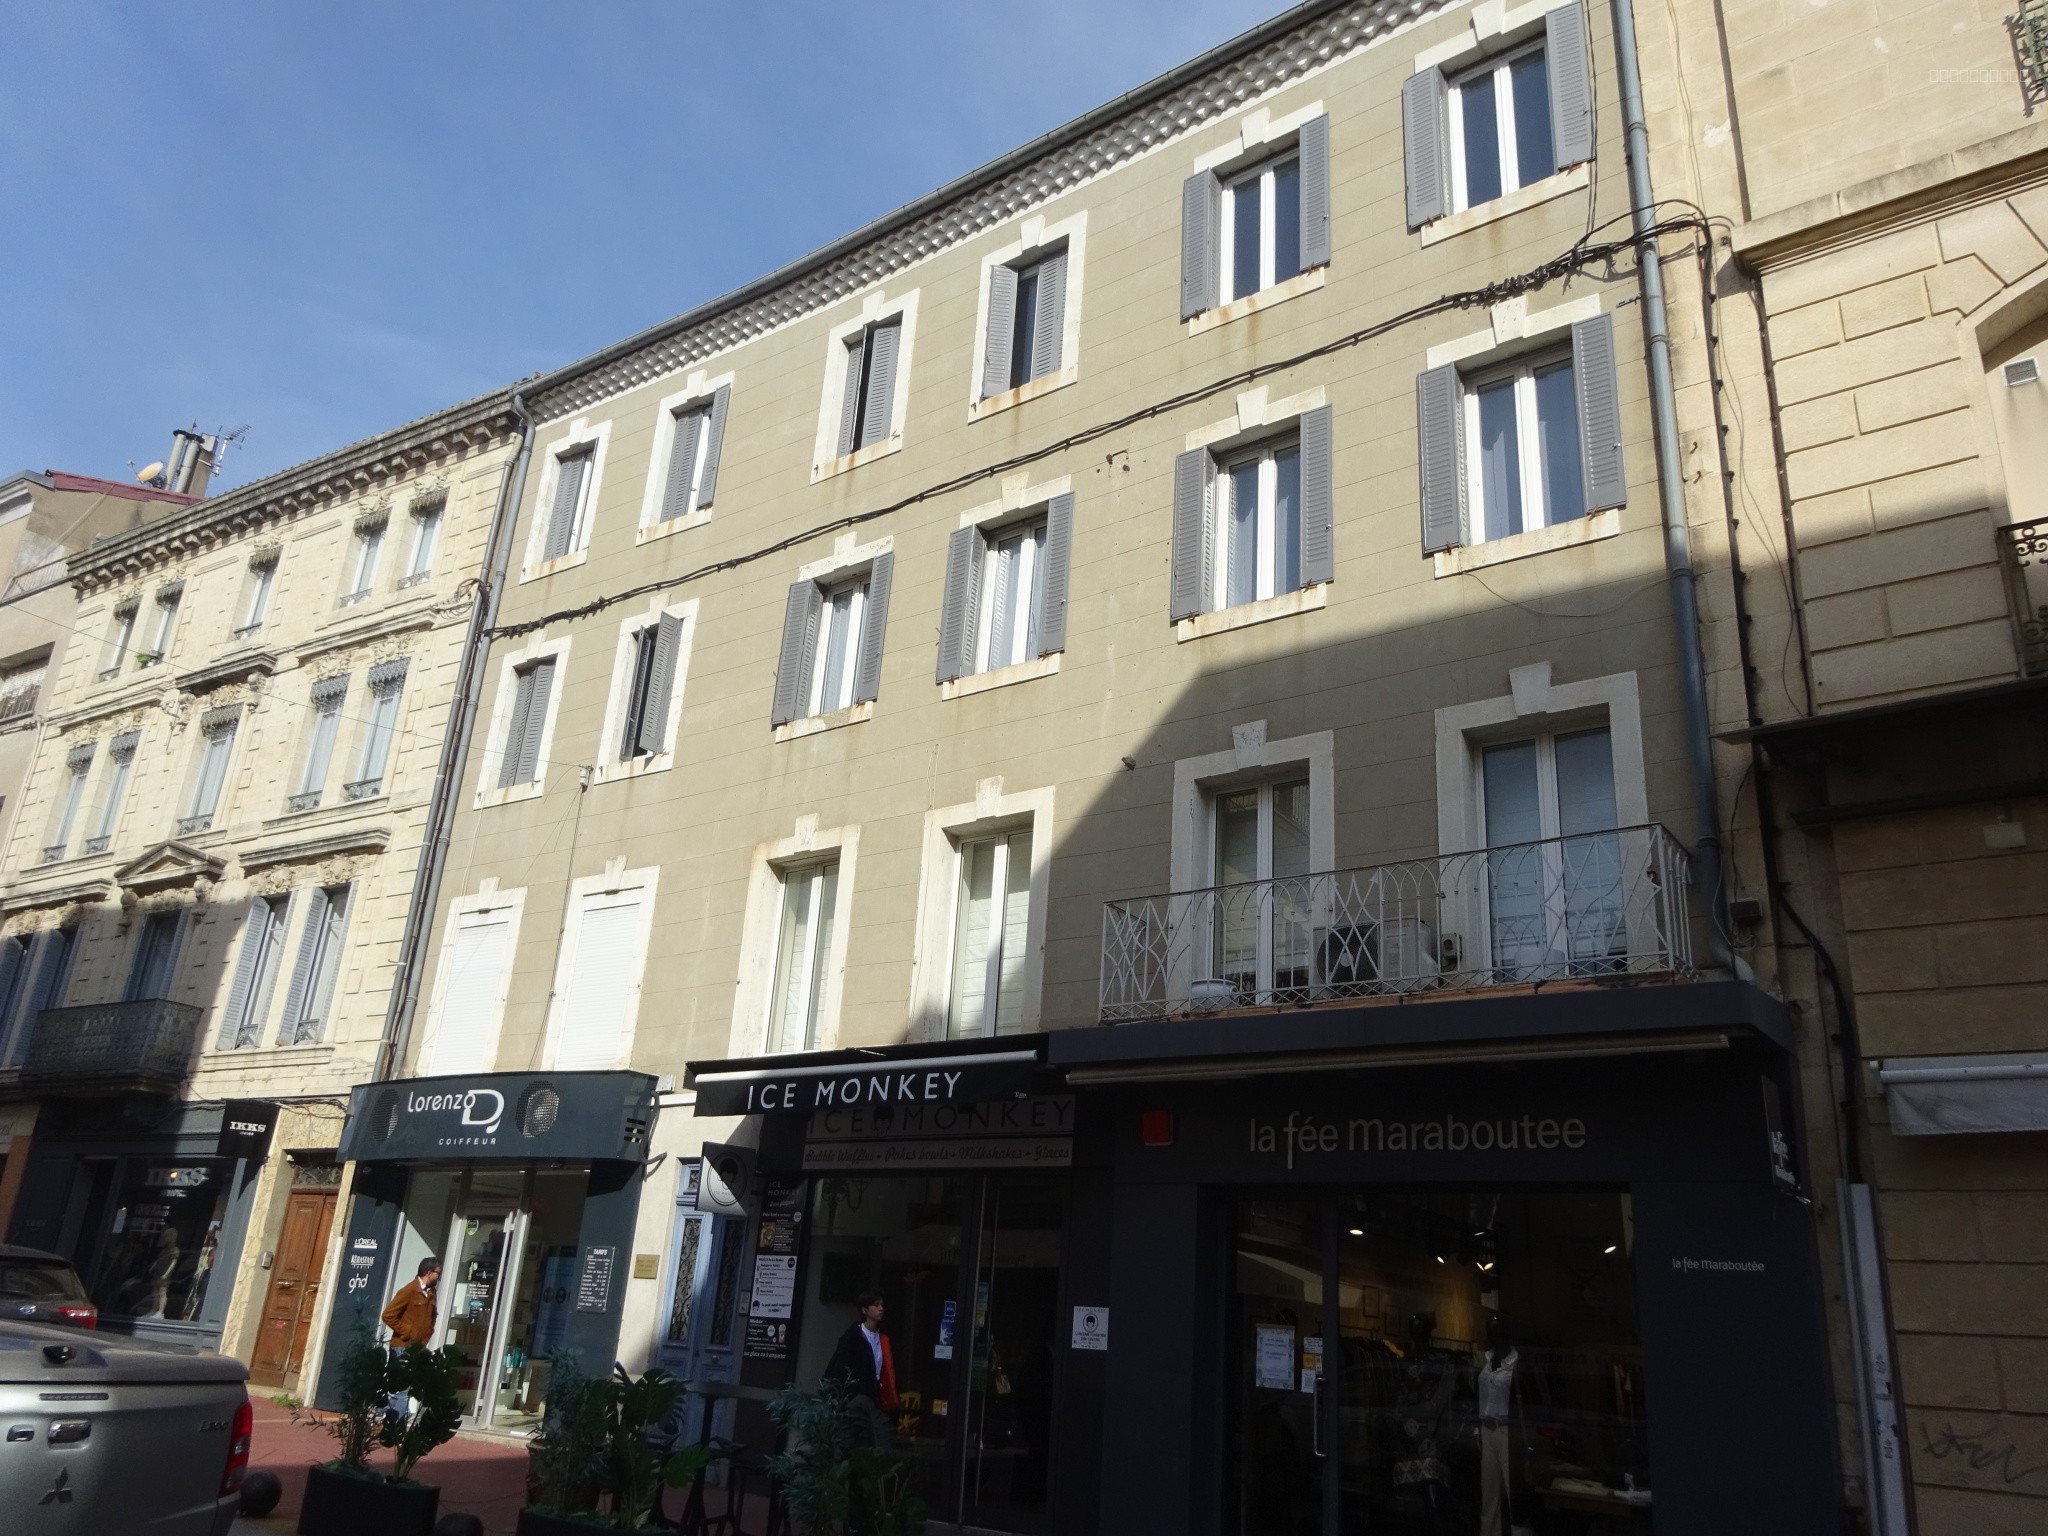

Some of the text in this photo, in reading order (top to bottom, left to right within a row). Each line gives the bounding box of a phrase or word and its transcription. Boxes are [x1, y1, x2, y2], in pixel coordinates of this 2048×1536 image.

[747, 1071, 963, 1110] ICE MONKEY
[229, 1121, 267, 1133] IKKS
[808, 1099, 1073, 1134] ICE MONKEY
[437, 1136, 497, 1146] COIFFEUR
[1250, 1118, 1277, 1153] la
[1282, 1110, 1340, 1170] fée
[958, 1144, 1023, 1161] Milkshakes
[1034, 1143, 1071, 1163] Glaces
[1672, 1258, 1681, 1269] la
[1682, 1256, 1700, 1273] fée
[348, 1272, 369, 1294] ghd
